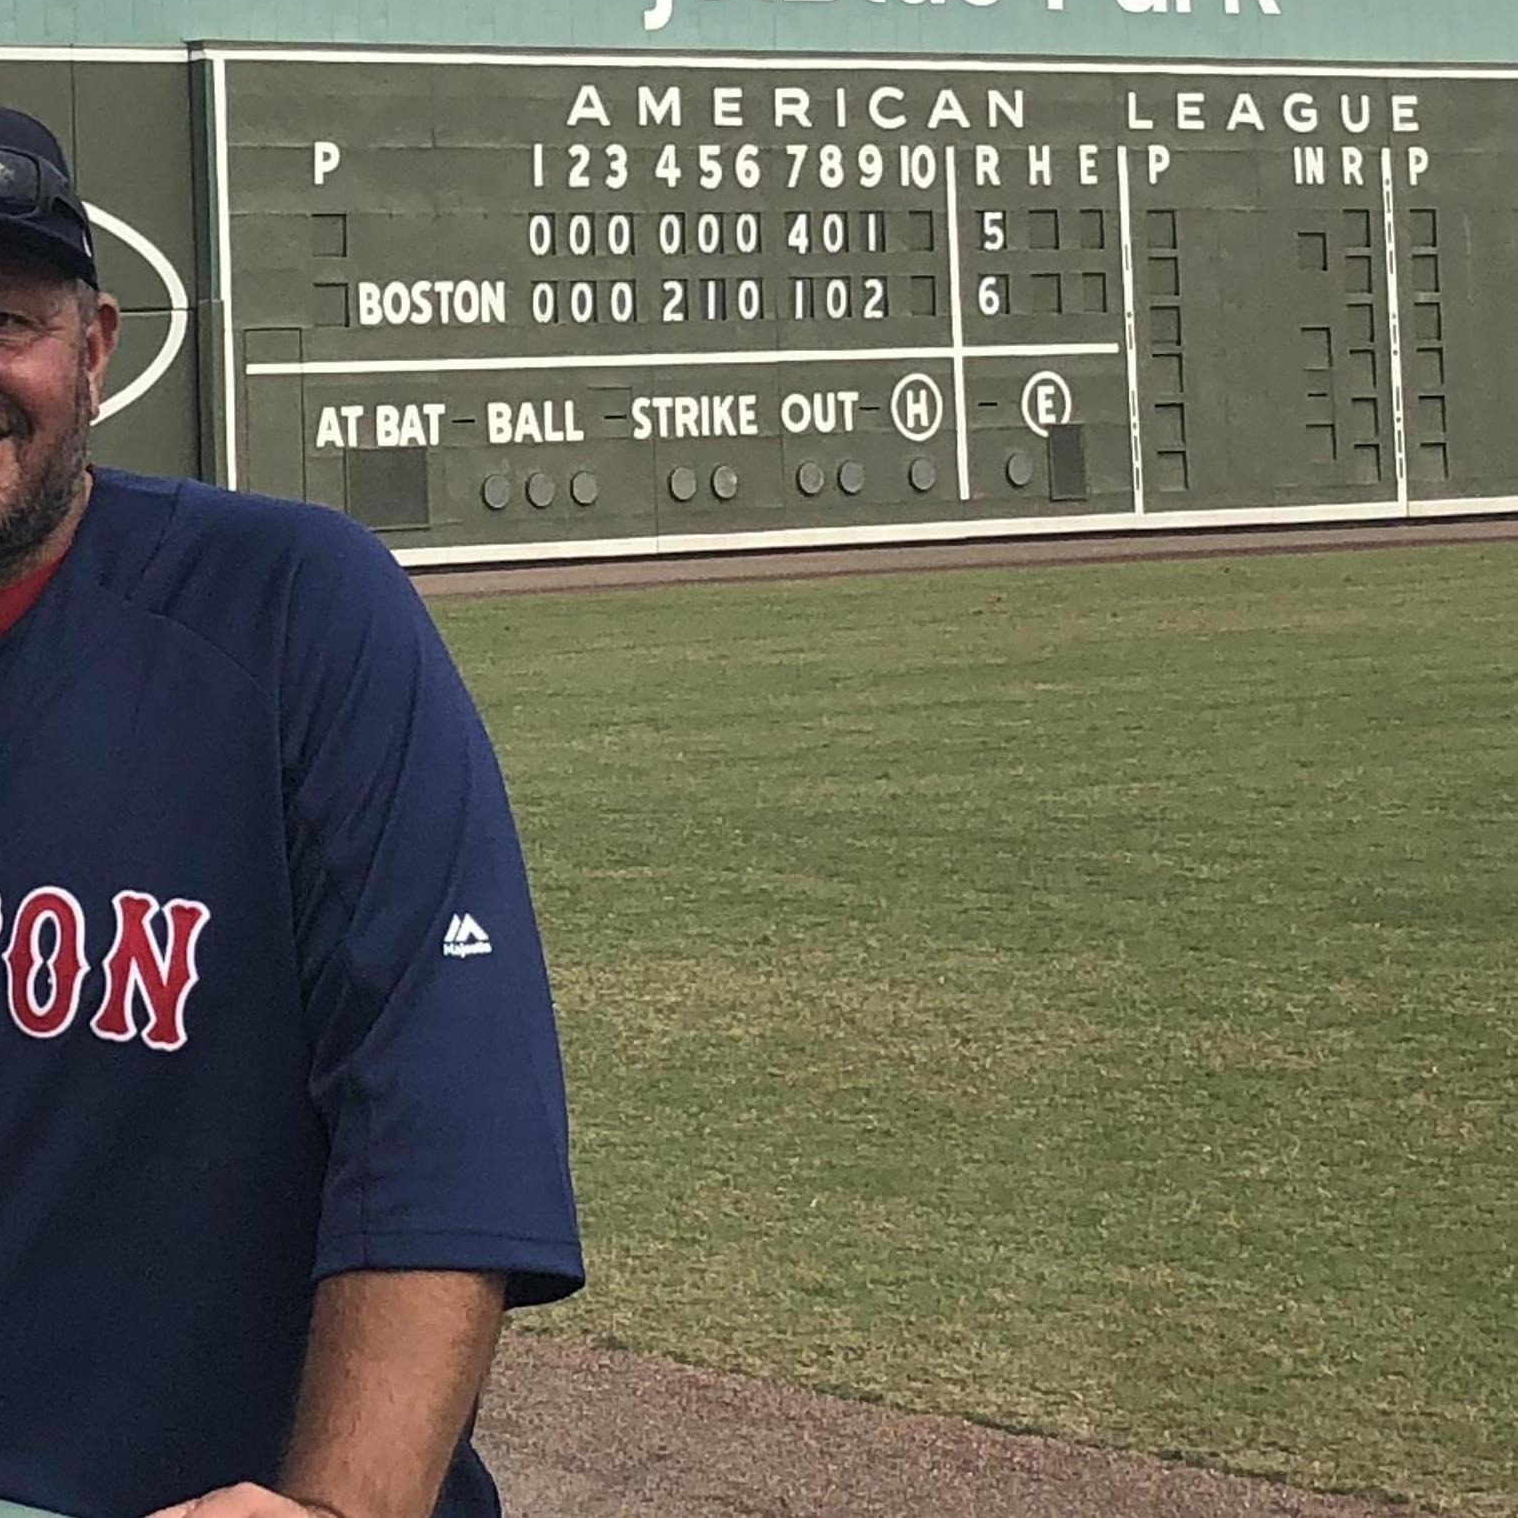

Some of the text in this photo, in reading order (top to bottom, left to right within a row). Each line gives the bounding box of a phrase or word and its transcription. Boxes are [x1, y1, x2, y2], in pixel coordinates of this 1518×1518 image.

[566, 85, 1420, 133] AMERICAN LEAGUE
[314, 141, 341, 185] P
[983, 211, 1004, 251] 5
[358, 279, 506, 326] BOSTON
[978, 276, 1000, 315] 6
[316, 405, 364, 448] AT
[376, 402, 446, 447] BAT
[487, 400, 585, 444] BALL
[631, 394, 759, 440] STRIKE
[781, 391, 859, 433] OUT
